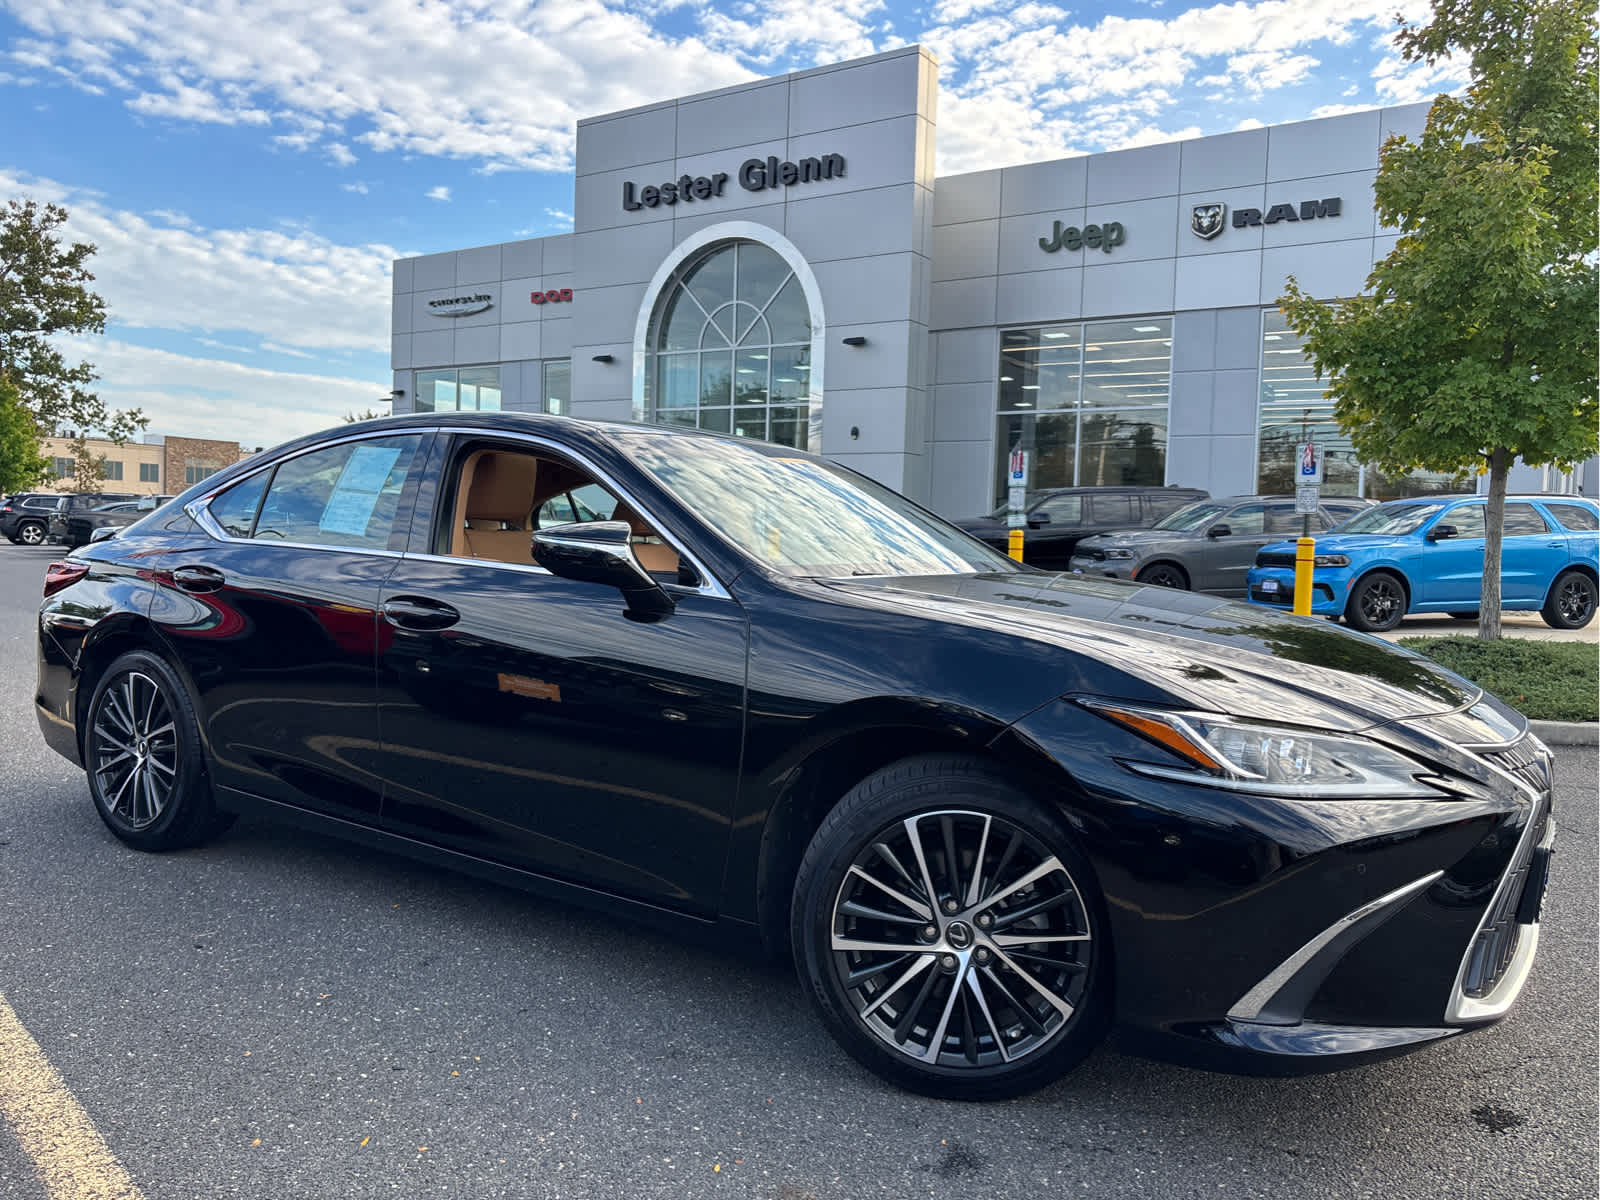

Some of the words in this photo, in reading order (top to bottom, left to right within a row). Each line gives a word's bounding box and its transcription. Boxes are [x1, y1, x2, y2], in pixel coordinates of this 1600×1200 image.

[623, 172, 728, 211] Lester
[738, 153, 845, 192] Glenn
[1232, 197, 1342, 228] RAM
[1038, 220, 1126, 253] Jeep
